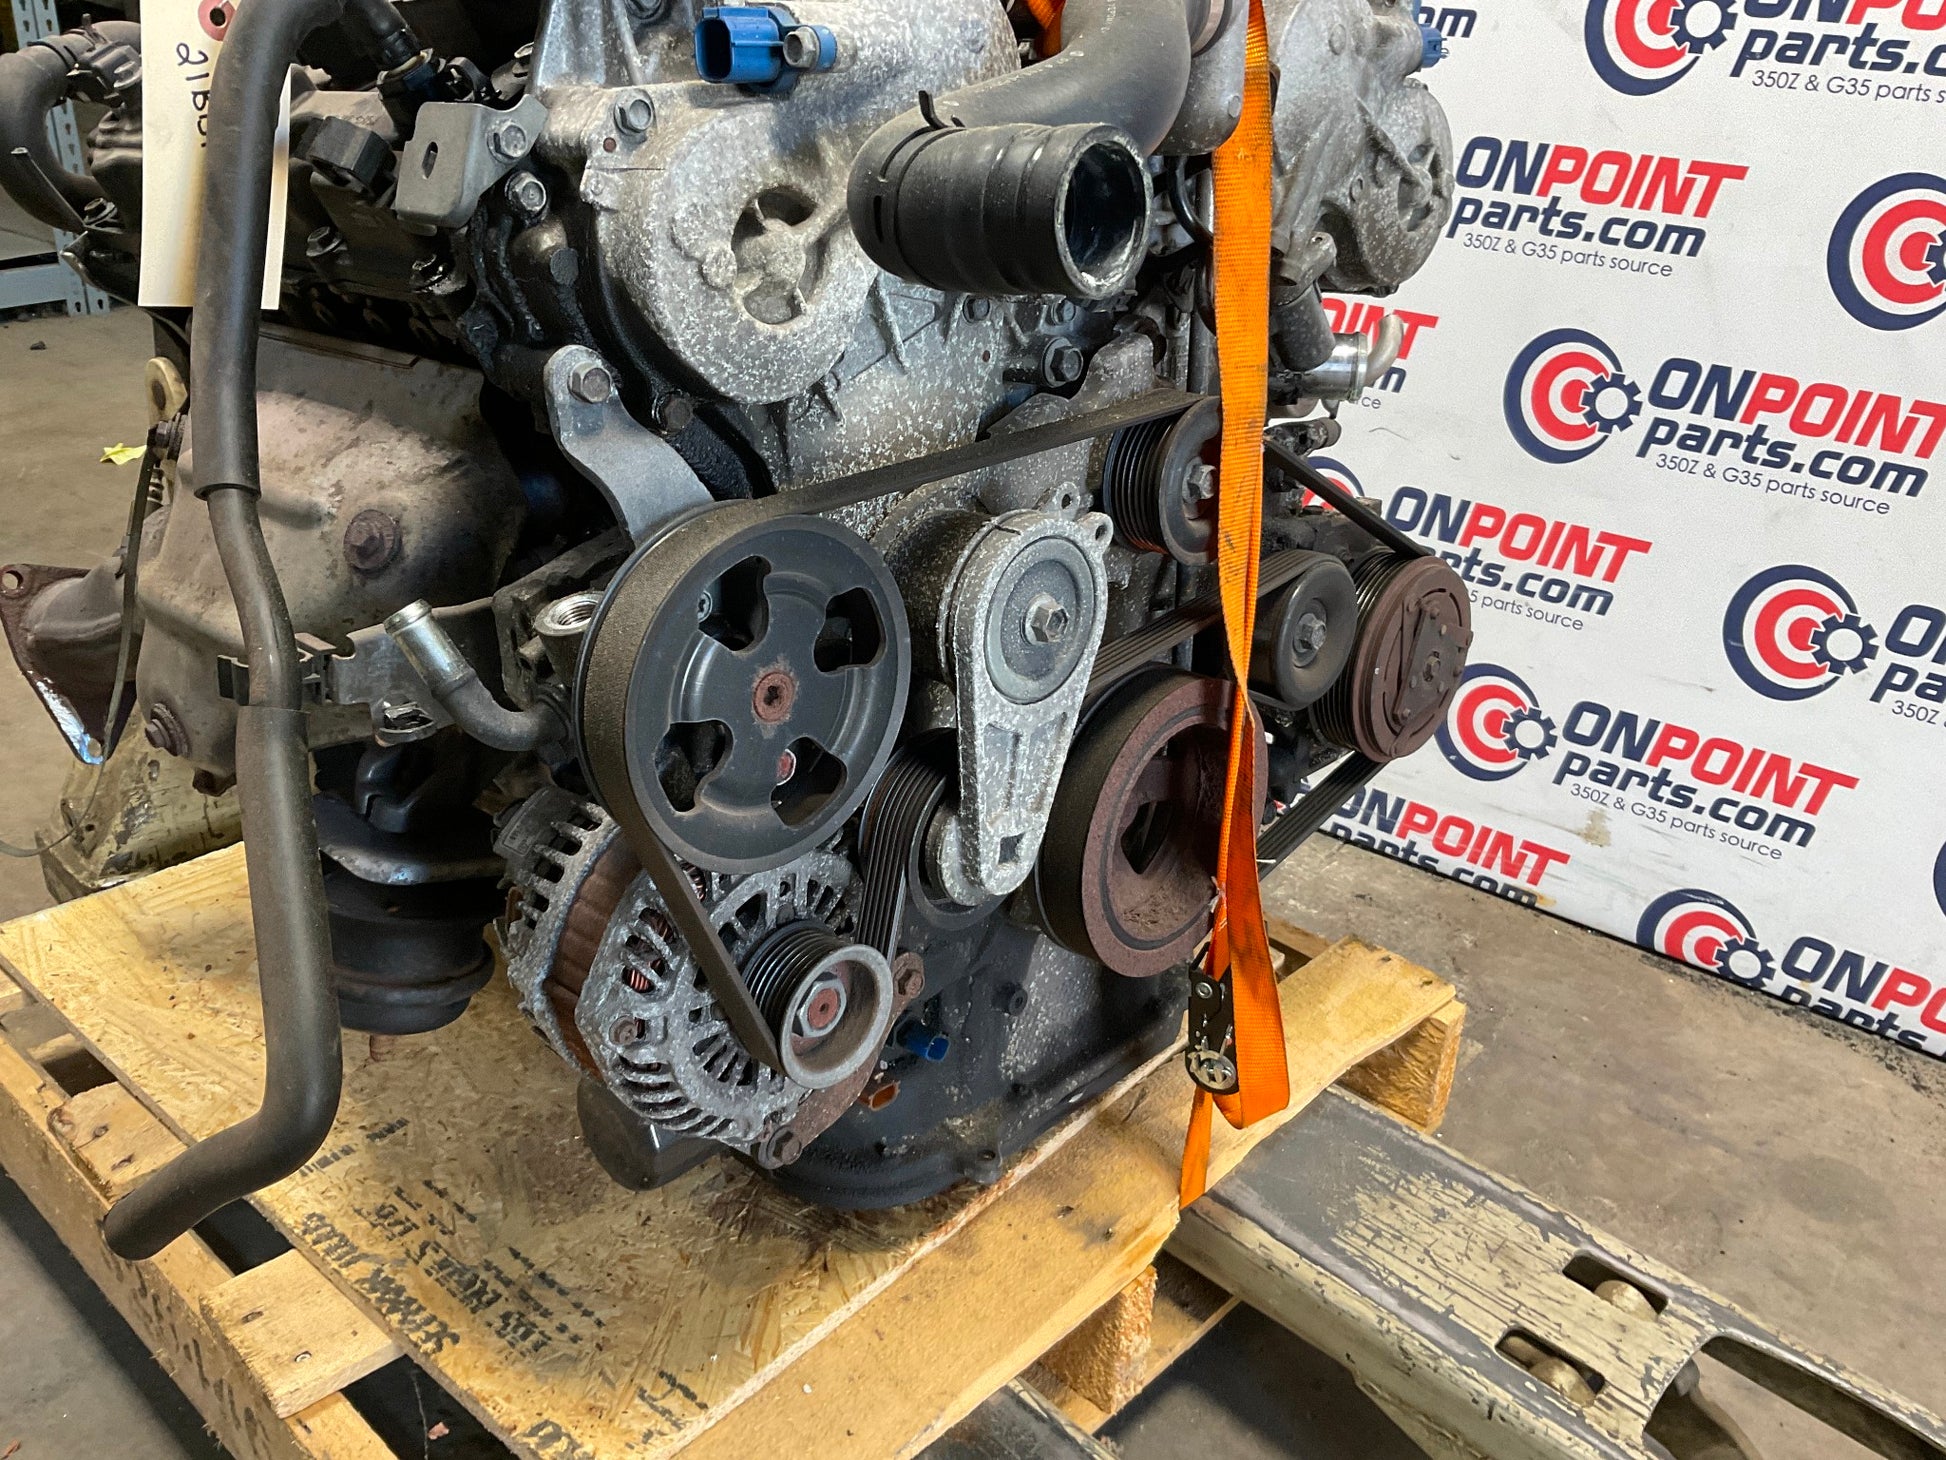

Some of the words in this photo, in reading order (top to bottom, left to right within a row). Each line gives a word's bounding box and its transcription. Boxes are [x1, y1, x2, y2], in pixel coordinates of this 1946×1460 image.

[1752, 70, 1800, 90] 350Z
[1805, 74, 1819, 92] &
[1827, 76, 1871, 97] G35
[1874, 83, 1931, 101] parts
[1455, 136, 1750, 218] ONPOINT
[1445, 196, 1706, 257] parts.com
[1463, 233, 1501, 253] 350Z
[1504, 239, 1517, 254] &
[1522, 241, 1557, 260] G35
[1560, 248, 1605, 268] parts
[1609, 257, 1673, 277] source
[1648, 357, 1946, 459] ONPOINT
[1635, 416, 1928, 497] parts.com
[1655, 453, 1700, 475] 350Z
[1703, 462, 1716, 479] &
[1722, 466, 1762, 487] G35
[1765, 475, 1816, 499] parts
[1820, 488, 1890, 515] source
[1385, 485, 1653, 583] ONPOINT
[1420, 545, 1615, 616] rts.com
[1481, 595, 1523, 616] parts
[1526, 606, 1584, 631] source
[1891, 699, 1940, 725] 350Z
[1562, 700, 1860, 816] ONPOINT
[1552, 750, 1816, 848] parts.com
[1570, 783, 1610, 807] 350Z
[1613, 796, 1625, 812] &
[1631, 800, 1667, 824] G35
[1669, 814, 1716, 839] parts
[1719, 832, 1783, 860] source
